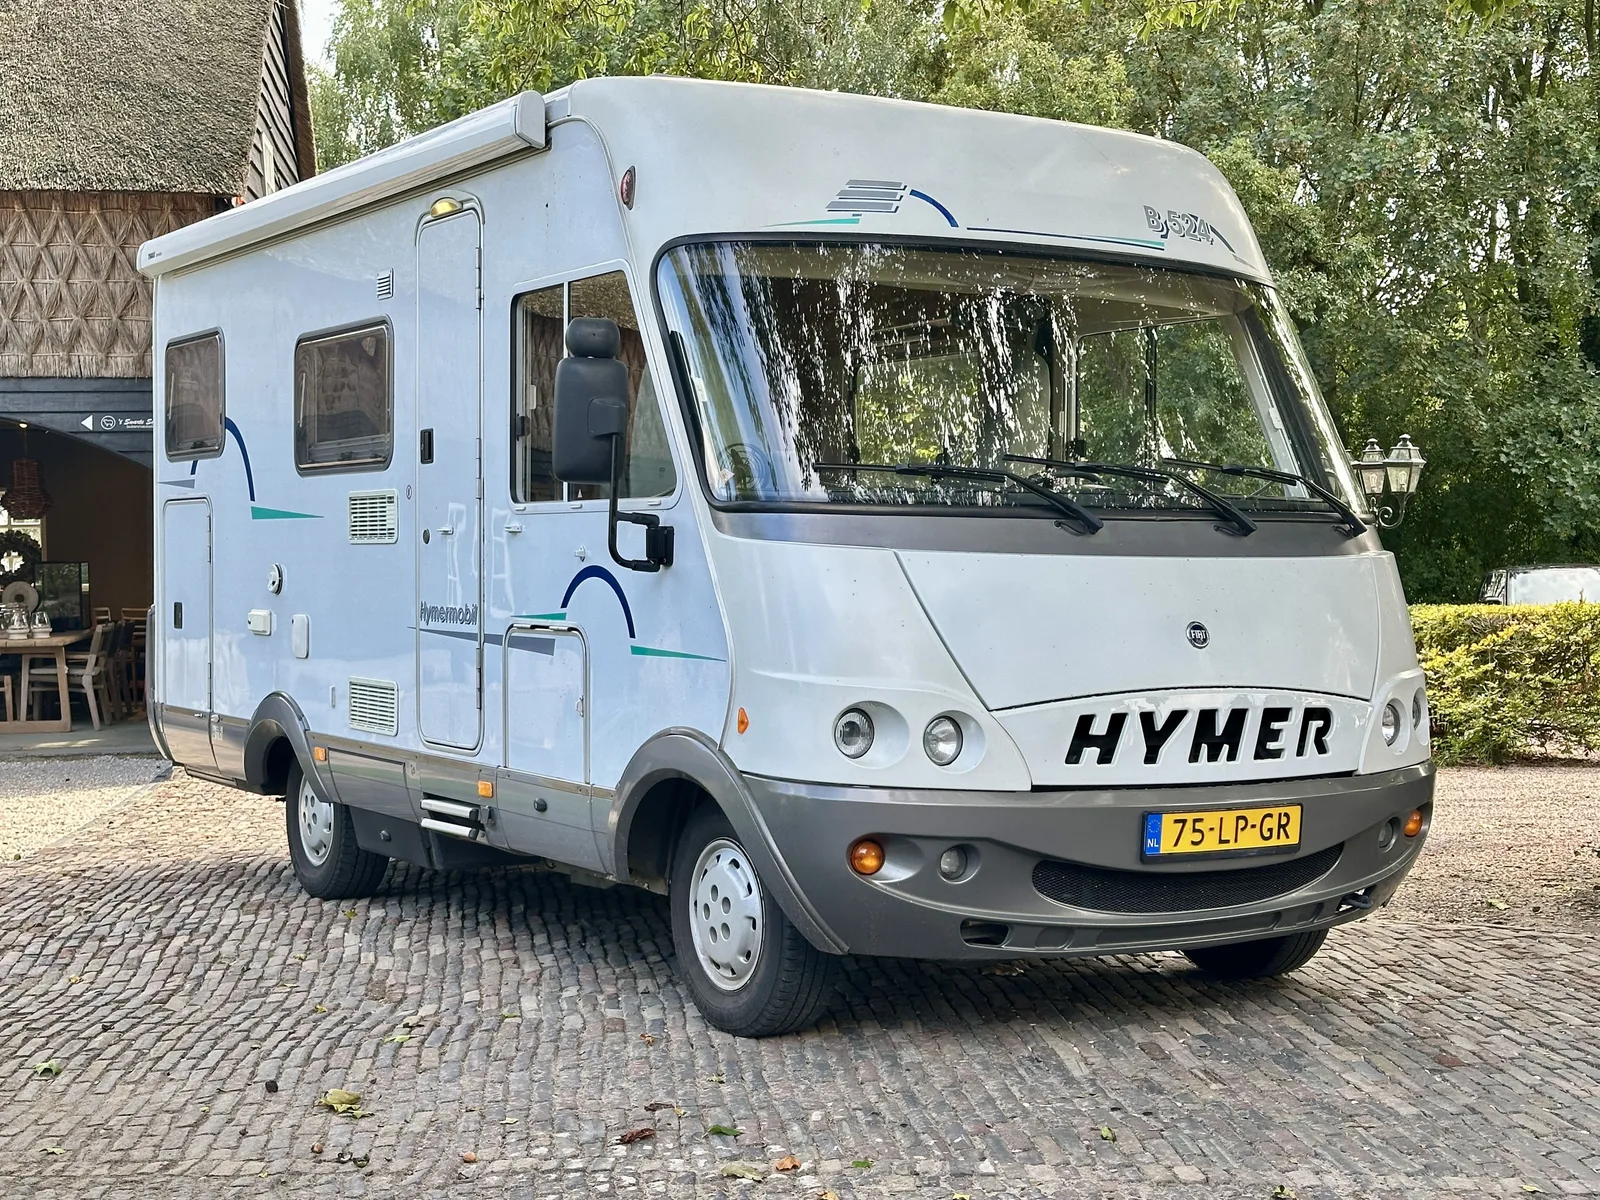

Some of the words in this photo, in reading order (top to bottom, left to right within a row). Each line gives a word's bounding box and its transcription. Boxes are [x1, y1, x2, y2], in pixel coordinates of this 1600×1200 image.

[1143, 205, 1163, 232] B
[1167, 210, 1213, 244] 524
[419, 600, 478, 626] Hymermobil
[1190, 629, 1206, 641] FIAT
[1064, 706, 1334, 765] HYMER
[1147, 838, 1159, 848] NL
[1173, 812, 1291, 848] 75-LP-GR
